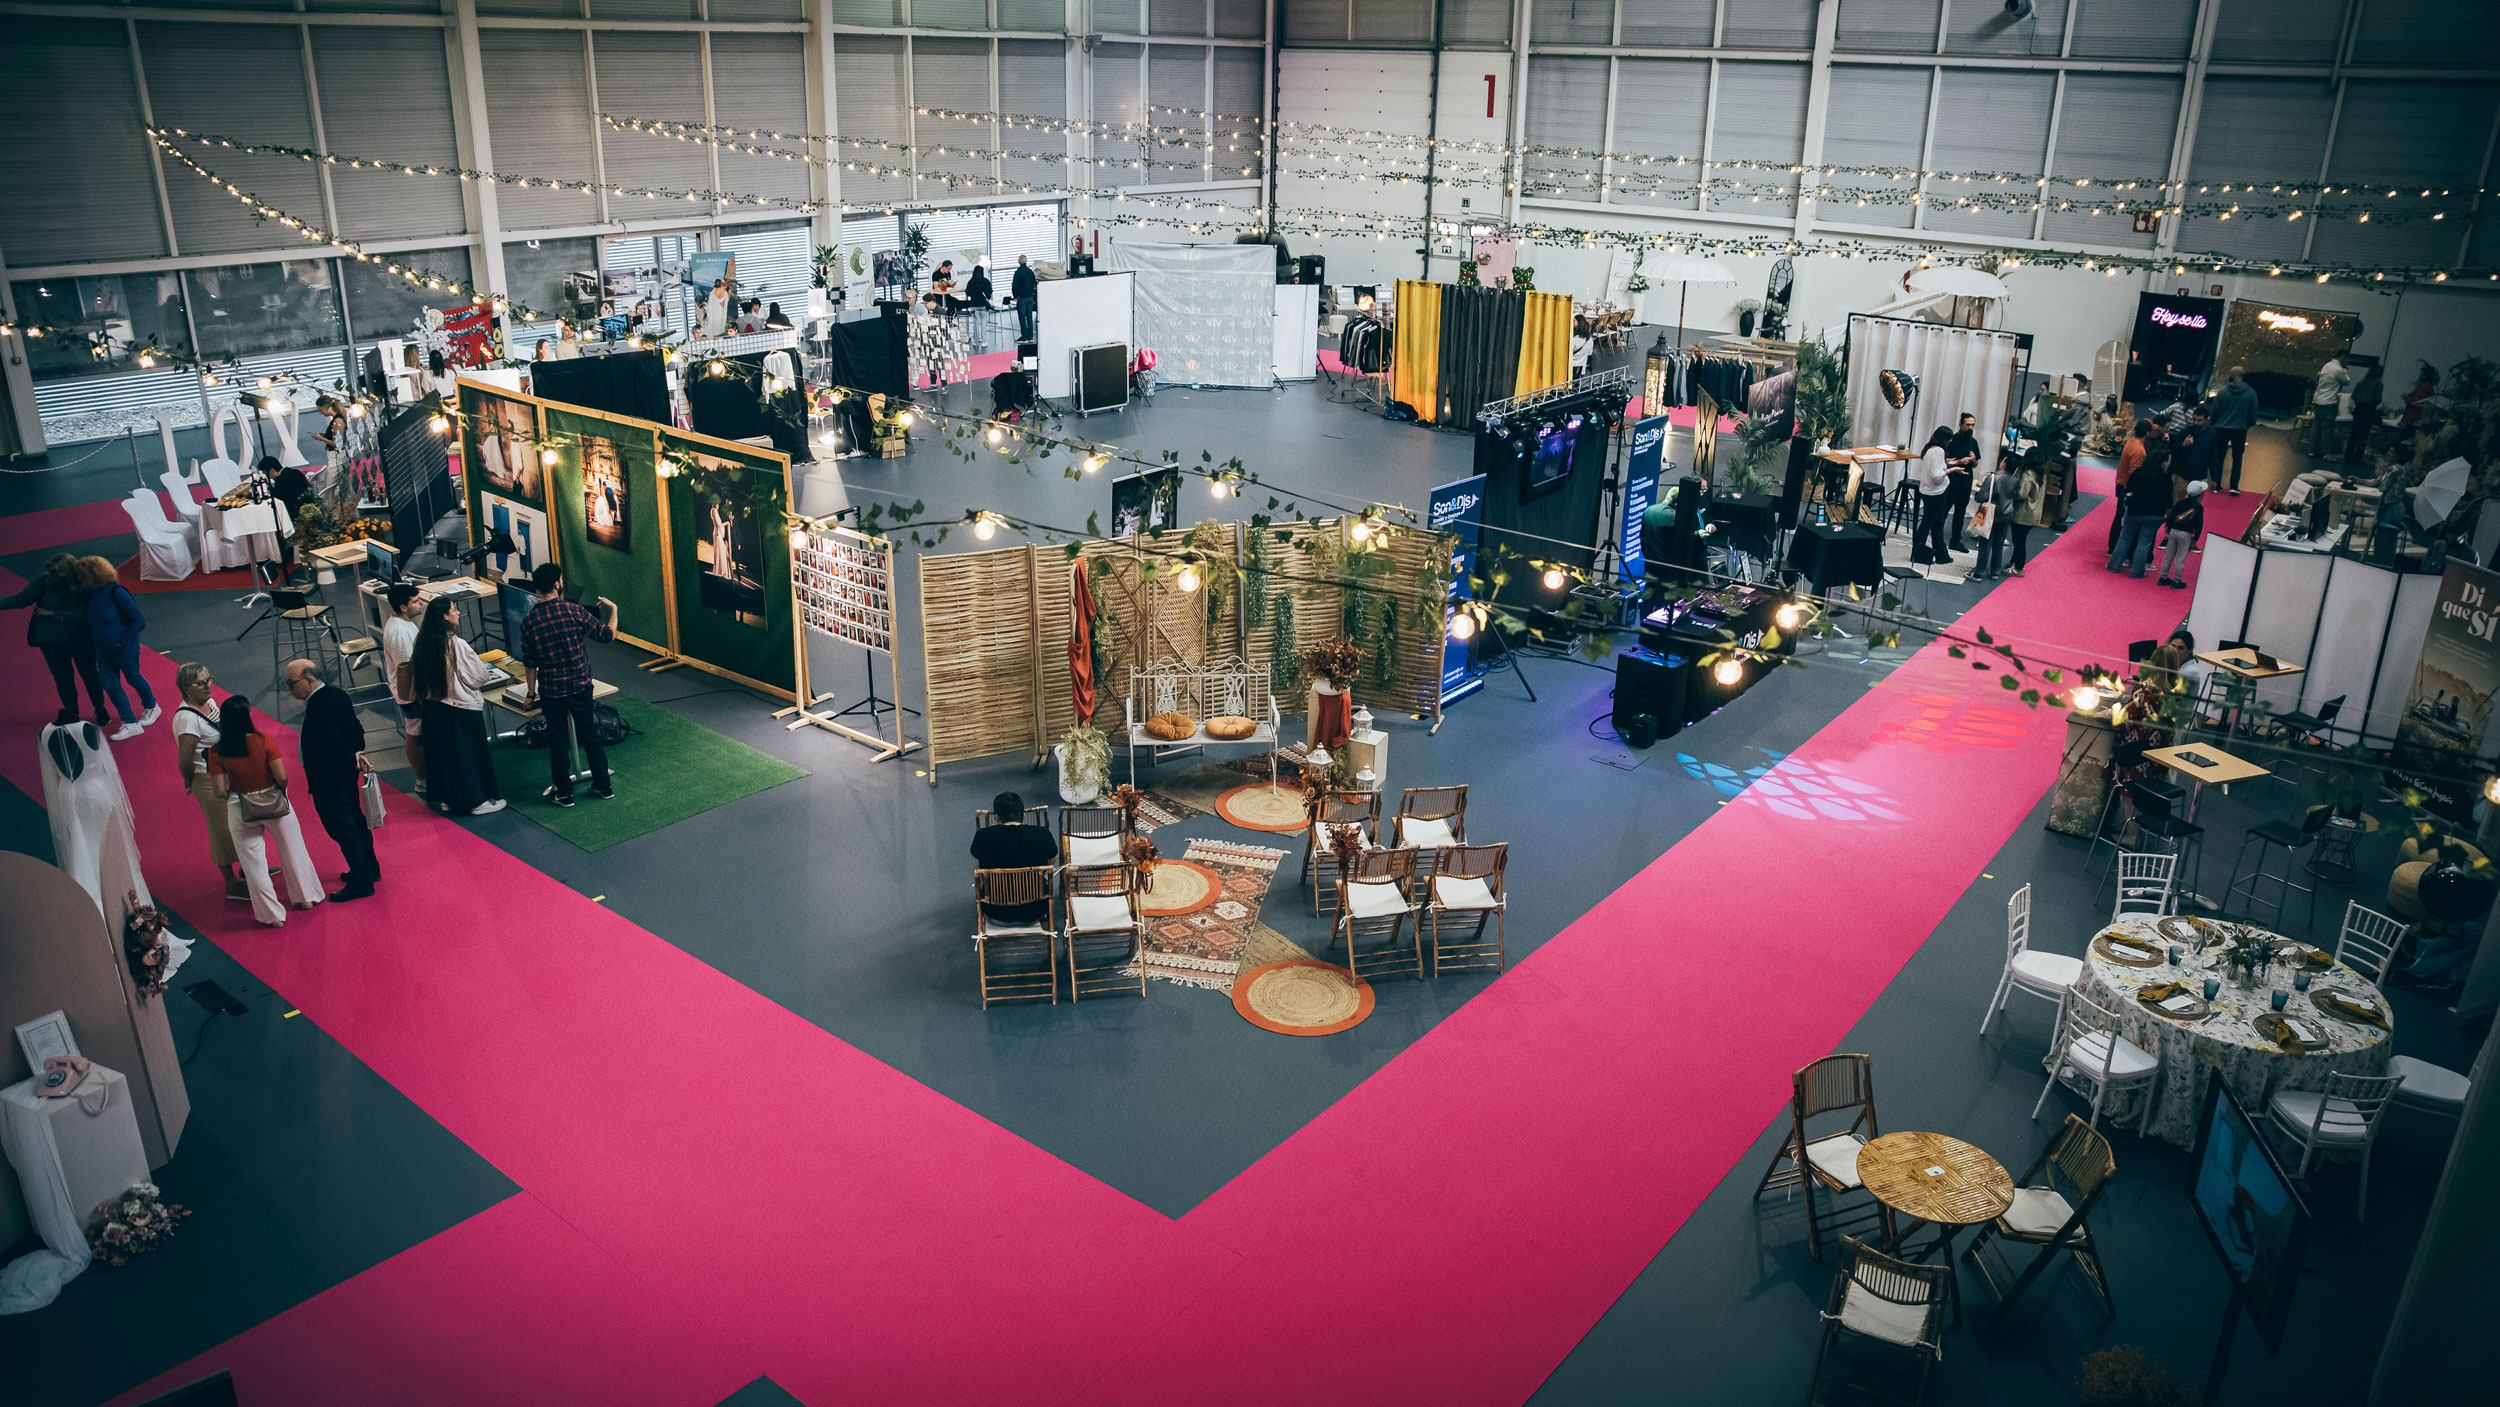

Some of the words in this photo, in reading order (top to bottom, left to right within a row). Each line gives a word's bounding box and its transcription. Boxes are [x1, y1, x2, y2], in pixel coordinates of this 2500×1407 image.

[1484, 74, 1496, 118] 1
[2151, 306, 2178, 328] Hoy
[1433, 494, 1472, 516] Son&Djs
[2460, 581, 2486, 608] Di
[2441, 600, 2471, 620] que
[2467, 604, 2500, 643] Sí
[2392, 768, 2413, 784] VIAJES
